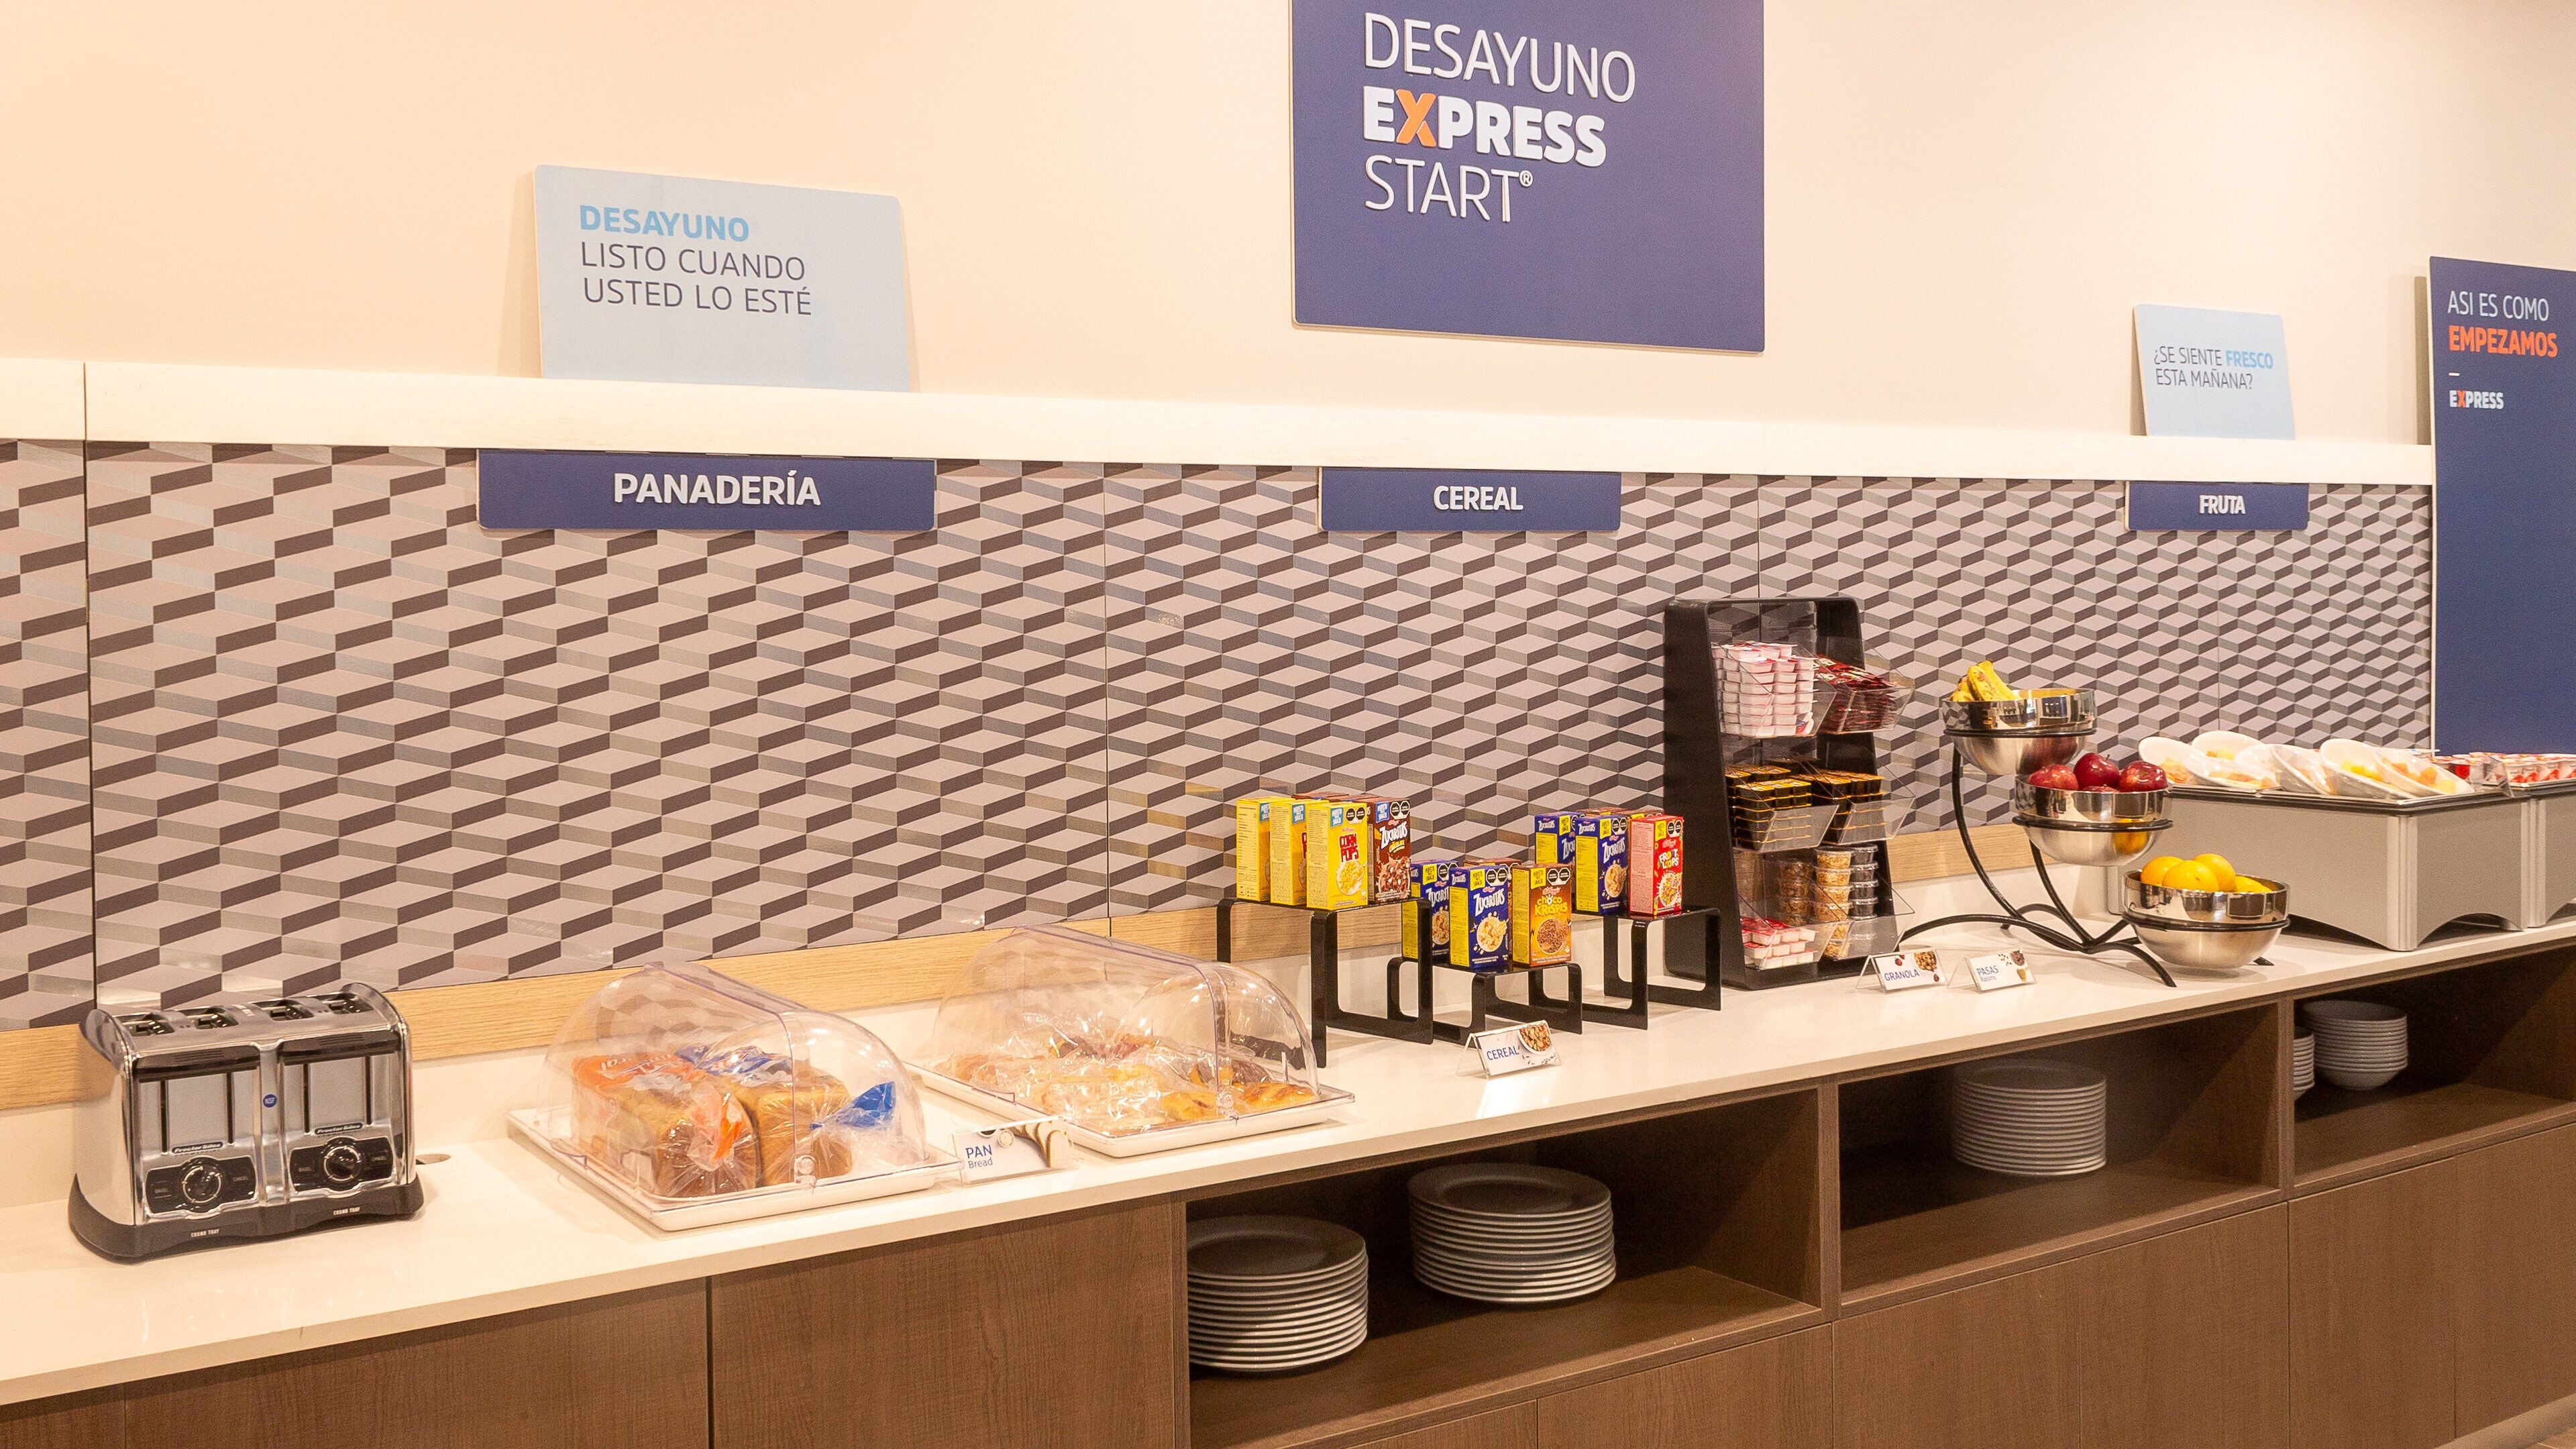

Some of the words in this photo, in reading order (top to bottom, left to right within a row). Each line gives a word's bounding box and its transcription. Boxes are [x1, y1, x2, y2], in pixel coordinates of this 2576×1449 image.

[1363, 11, 1636, 103] DESAYUNO
[1362, 85, 1608, 168] EXPRESS
[580, 205, 750, 242] DESAYUNO
[581, 241, 666, 271] LISTO
[678, 248, 806, 280] CUANDO
[584, 277, 682, 307] USTED
[696, 284, 733, 311] LO
[745, 286, 812, 315] ESTÉ
[2447, 290, 2473, 315] ASI
[2479, 293, 2498, 317] ES
[2503, 295, 2549, 321] COMO
[2449, 325, 2558, 358] EMPEZAMOS
[2153, 345, 2176, 365] ¿SE
[2180, 347, 2222, 366] SIENTE
[2225, 350, 2273, 369] FRESCO
[2155, 369, 2187, 386] ESTA
[2191, 368, 2253, 389] MAÑANA?
[2449, 390, 2504, 409] EXPRESS
[613, 470, 821, 506] PANADERÍA
[1433, 485, 1523, 511] CEREAL
[2199, 494, 2246, 515] FRUTA
[1339, 833, 1357, 849] CORN
[1379, 820, 1407, 849] ZUCARITAS
[1340, 847, 1359, 862] POPS
[1602, 837, 1625, 864] ZUCARITAS
[1426, 886, 1449, 908] ZUCARIT
[1473, 888, 1505, 917] ZUCARITAS
[1534, 902, 1568, 916] KRISPIS
[1884, 968, 1920, 981] GRANOLA
[1976, 965, 1999, 975] PASAS
[1487, 1045, 1519, 1061] CEREAL
[965, 1144, 993, 1159] PAN
[968, 1157, 994, 1169] Bread
